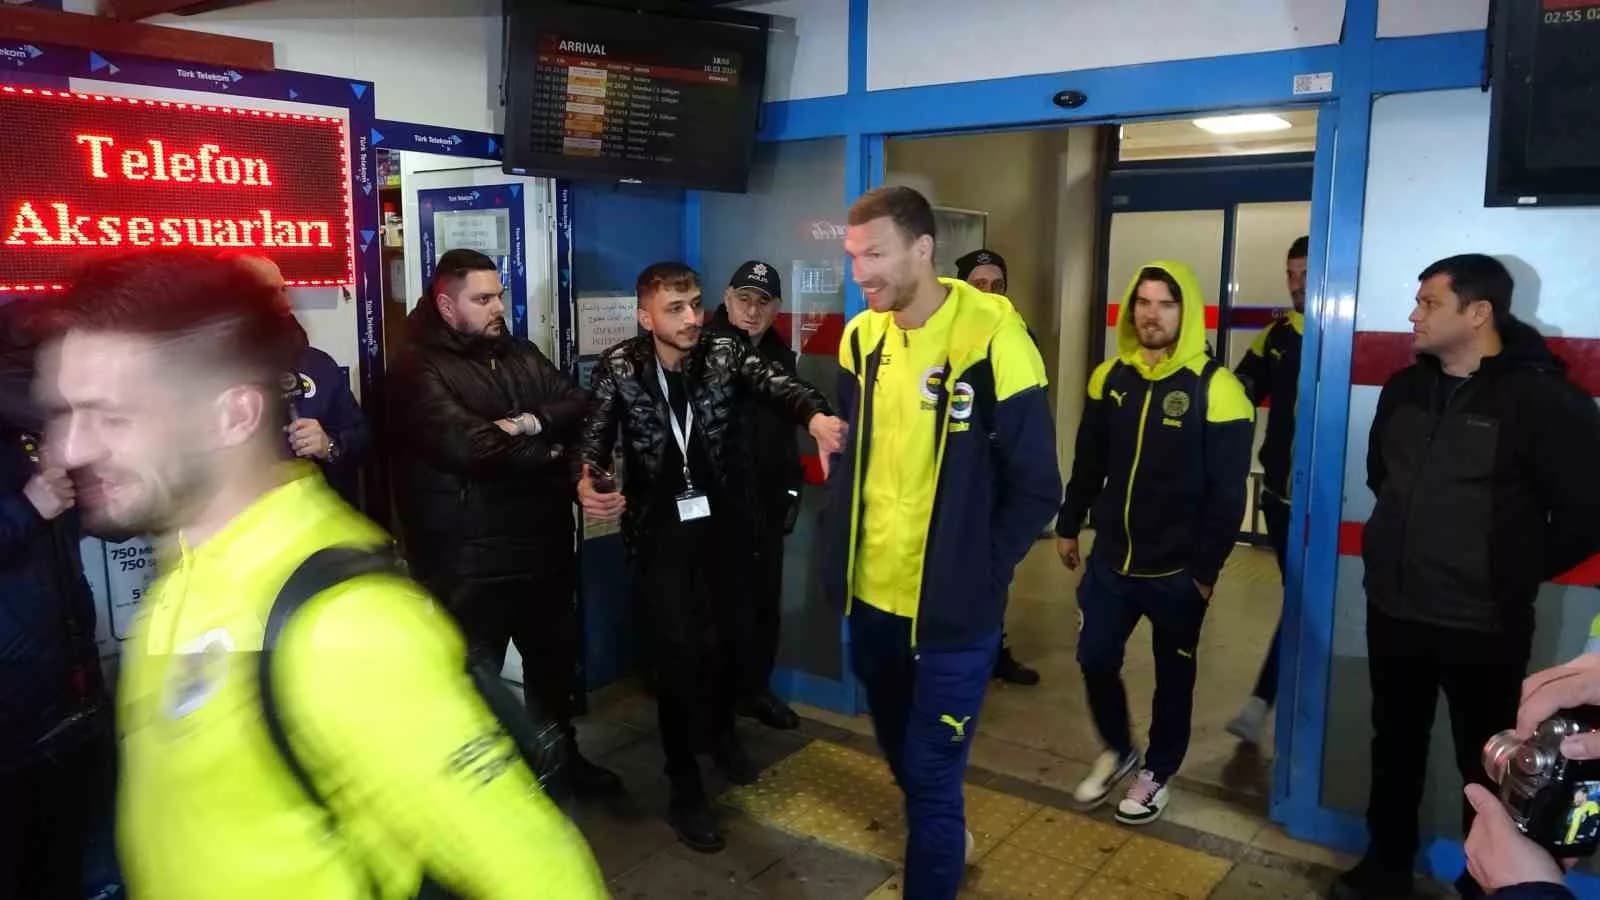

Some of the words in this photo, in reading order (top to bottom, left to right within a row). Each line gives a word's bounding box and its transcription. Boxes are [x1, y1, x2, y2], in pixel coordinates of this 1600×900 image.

[1544, 10, 1582, 24] 02:55
[559, 40, 607, 56] ARRIVAL
[177, 69, 196, 79] Türk
[197, 71, 230, 82] Telekom
[414, 134, 428, 143] Türk
[429, 136, 453, 145] Telekom
[77, 135, 273, 186] Telefon
[360, 153, 369, 183] Telekom
[5, 202, 333, 247] Aksesuarları
[366, 300, 374, 315] Türk
[111, 547, 137, 560] 750
[120, 558, 146, 572] 750
[132, 588, 141, 600] 5
